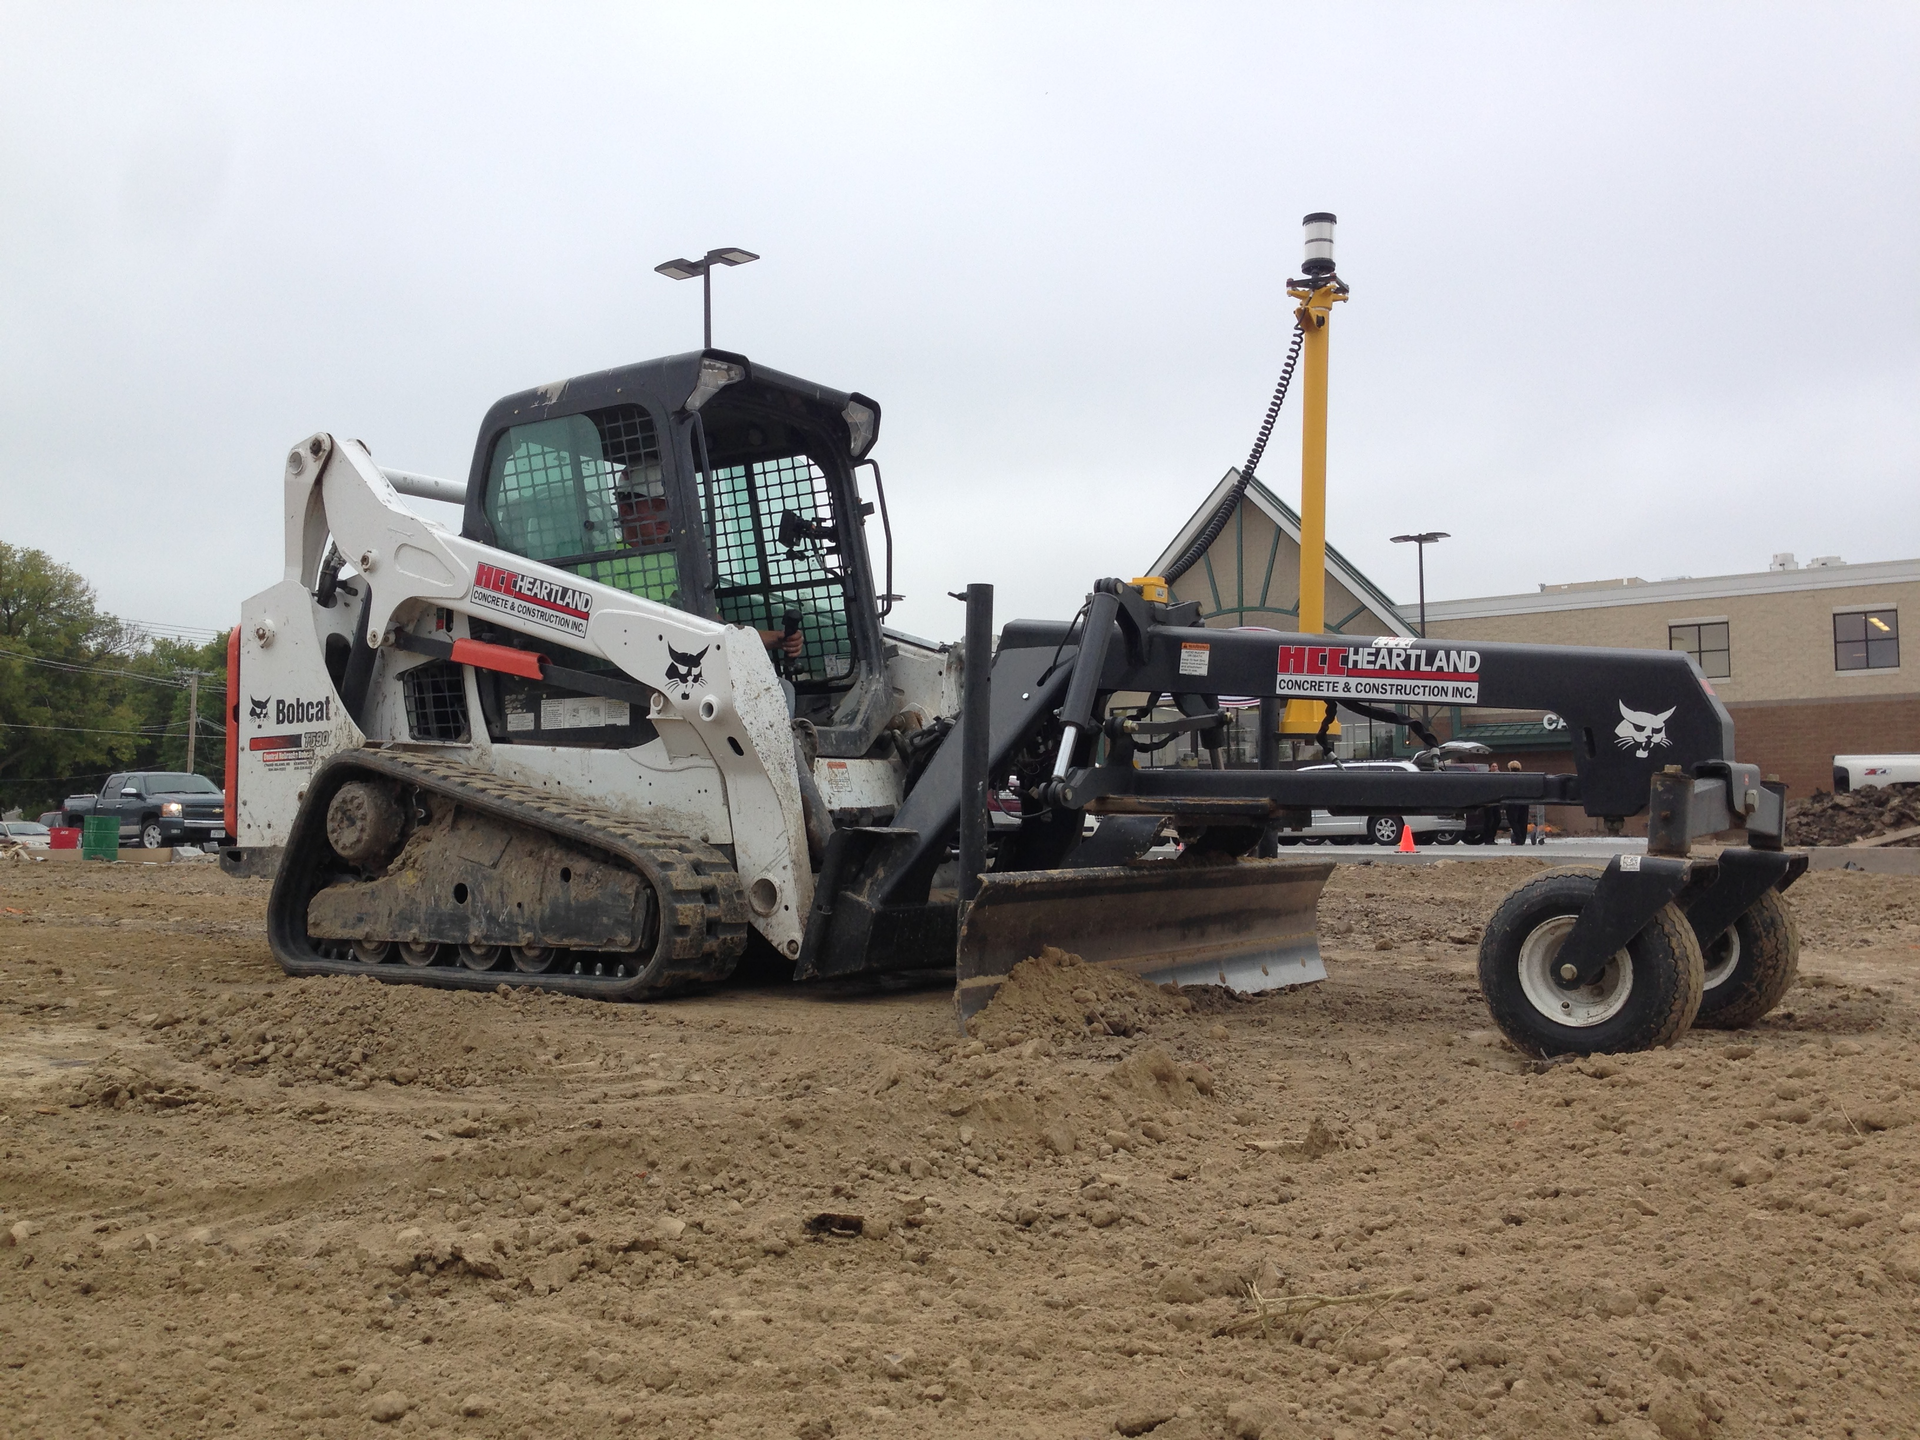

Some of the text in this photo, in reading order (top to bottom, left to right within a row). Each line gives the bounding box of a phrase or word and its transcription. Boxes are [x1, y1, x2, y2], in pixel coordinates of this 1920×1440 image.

[516, 575, 592, 613] HEARTLAND
[473, 590, 585, 633] CONCRETE & CONSTRUCTION INC.
[1278, 645, 1480, 676] HCC HEARTLAND
[1278, 679, 1475, 699] CONCRETE & CONSTRUCTION INC.
[276, 696, 331, 725] Bobcat
